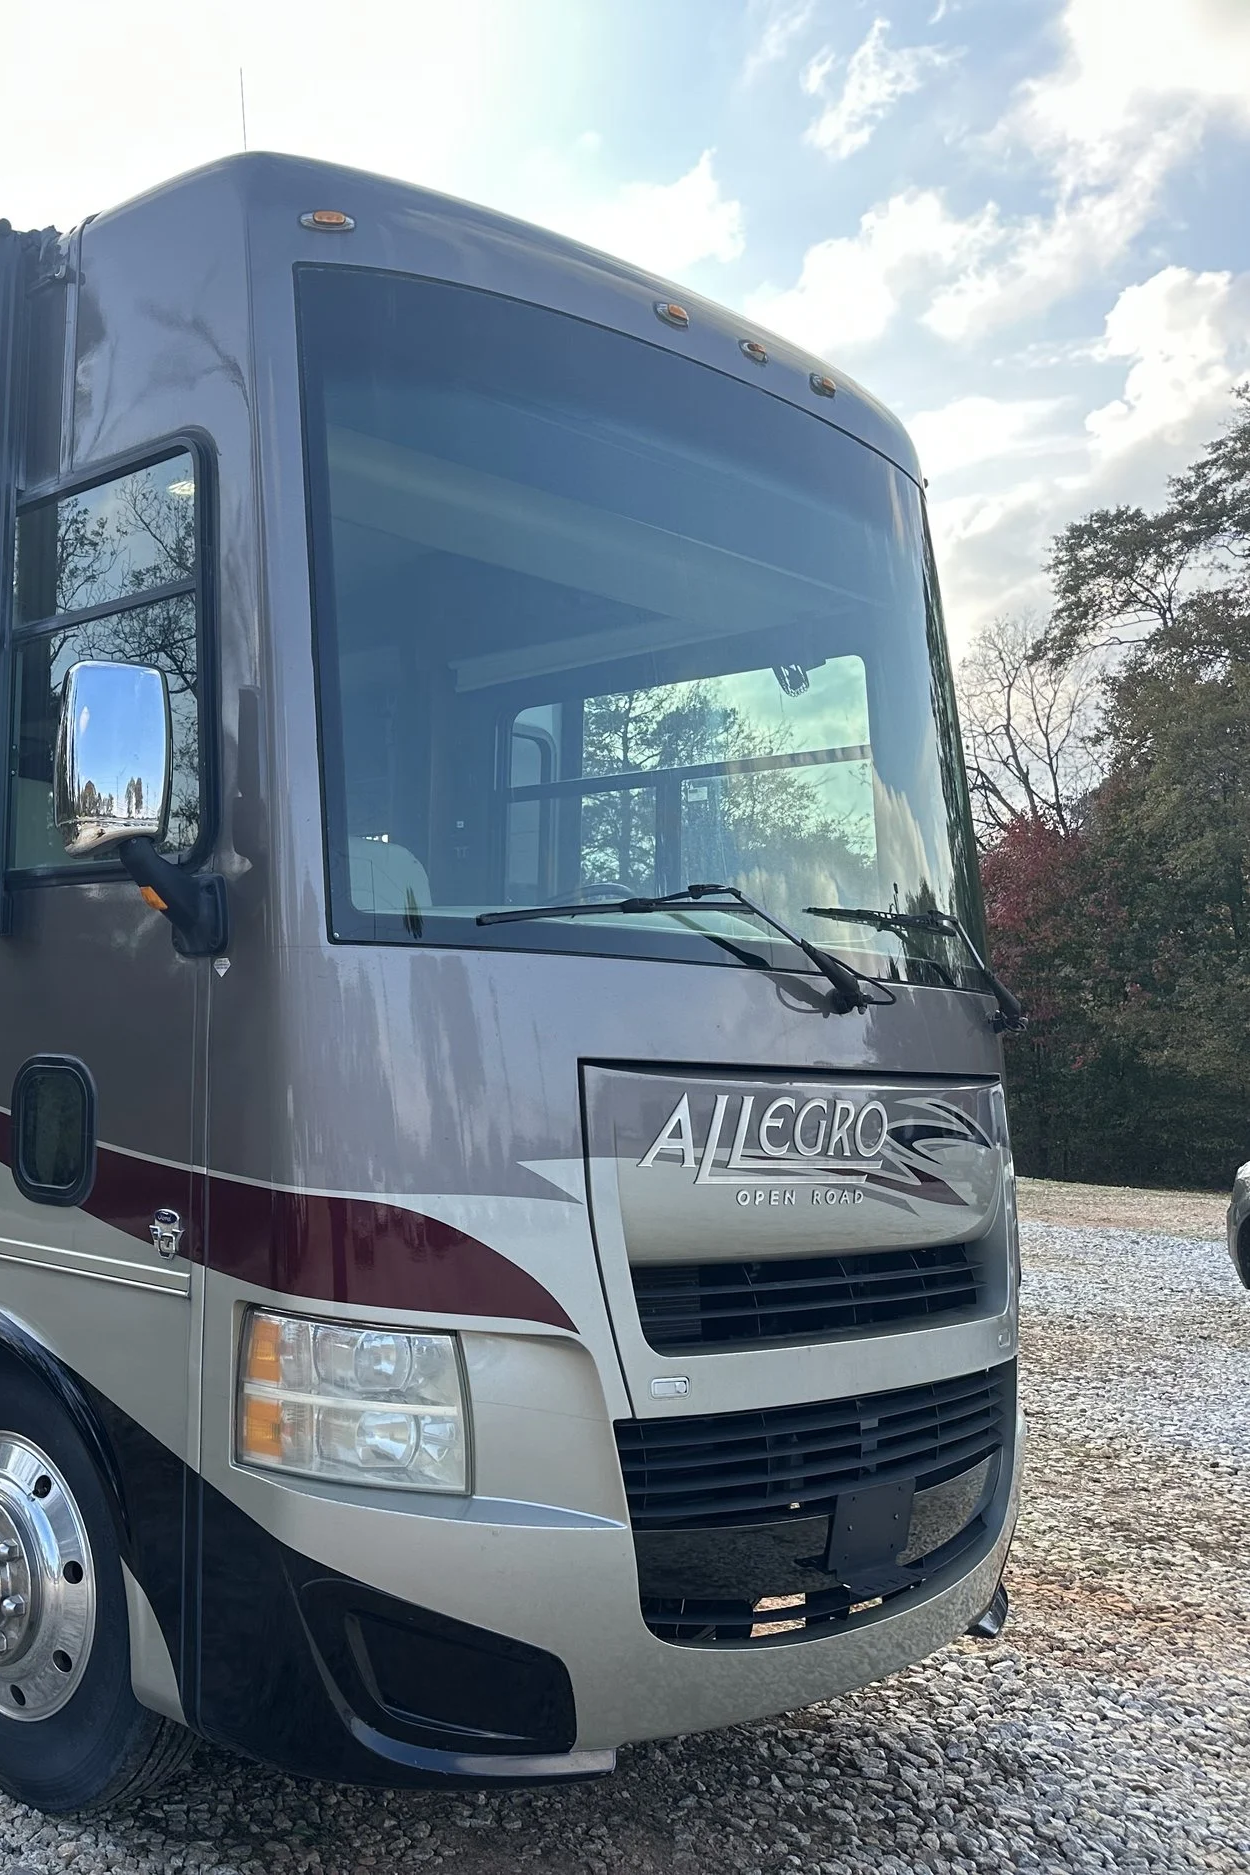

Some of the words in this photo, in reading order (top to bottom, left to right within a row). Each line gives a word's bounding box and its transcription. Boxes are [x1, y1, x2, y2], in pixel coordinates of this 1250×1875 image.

[636, 1091, 888, 1185] ALLEGRO
[736, 1188, 796, 1206] OPEN
[811, 1188, 865, 1206] ROAD
